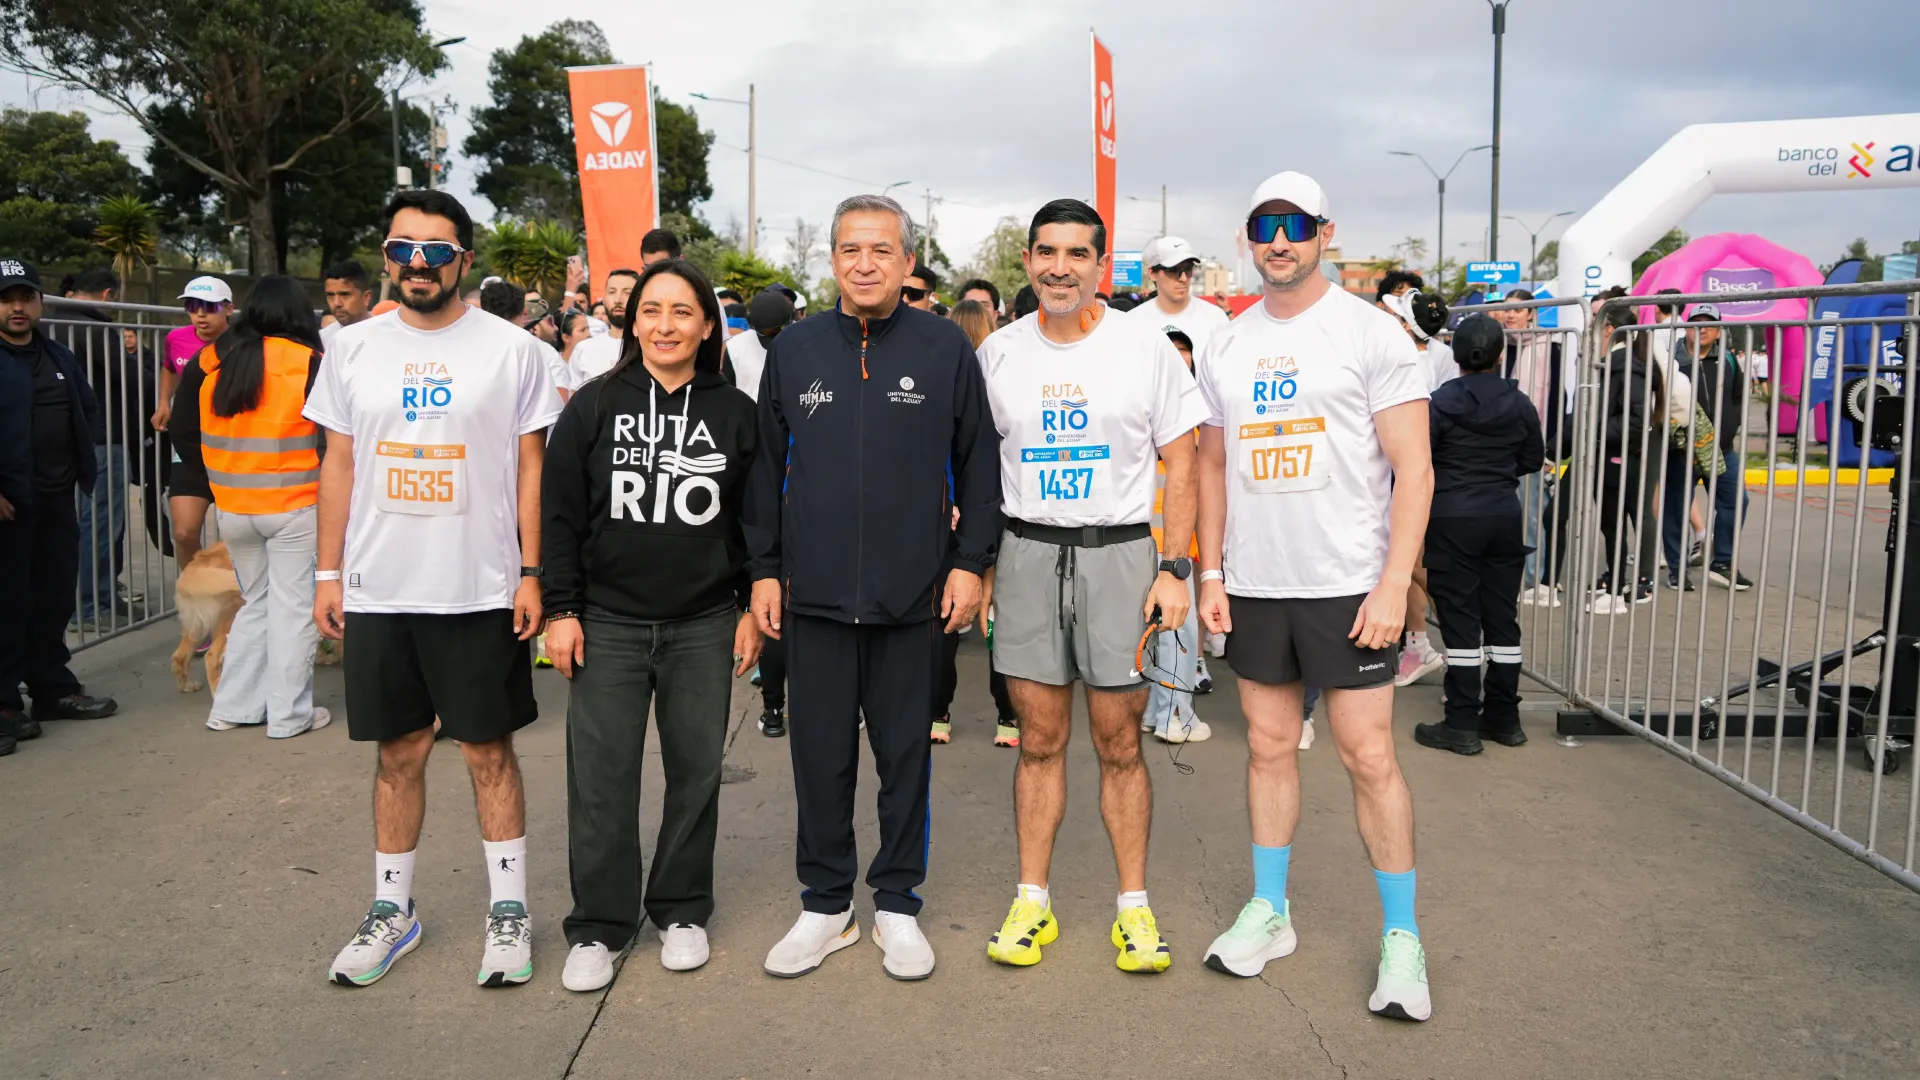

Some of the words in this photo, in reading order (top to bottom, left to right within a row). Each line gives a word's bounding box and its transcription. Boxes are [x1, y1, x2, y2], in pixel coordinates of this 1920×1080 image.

[1778, 147, 1838, 162] banco
[1885, 144, 1920, 173] a
[1808, 162, 1837, 176] del
[3, 268, 26, 277] RIO
[1470, 263, 1516, 272] ENTRADA
[1708, 276, 1758, 293] Bassa
[404, 362, 449, 376] RUTA
[1257, 356, 1296, 370] RUTA
[403, 377, 420, 386] DEL
[1254, 371, 1271, 380] DEL
[402, 386, 452, 409] RIO
[887, 391, 926, 400] UNIVERSIDAD
[1042, 384, 1084, 398] RUTA
[1253, 379, 1297, 402] RIO
[799, 391, 834, 406] PUMAS
[1042, 400, 1058, 408] DEL
[1042, 409, 1088, 431] RIO
[614, 413, 717, 449] RUTA
[1273, 424, 1284, 436] 5K
[413, 447, 425, 459] 5K
[612, 447, 650, 466] DEL
[1251, 444, 1313, 480] 0757
[387, 467, 454, 503] 0535
[1039, 467, 1094, 500] 1437
[610, 470, 721, 526] RIO
